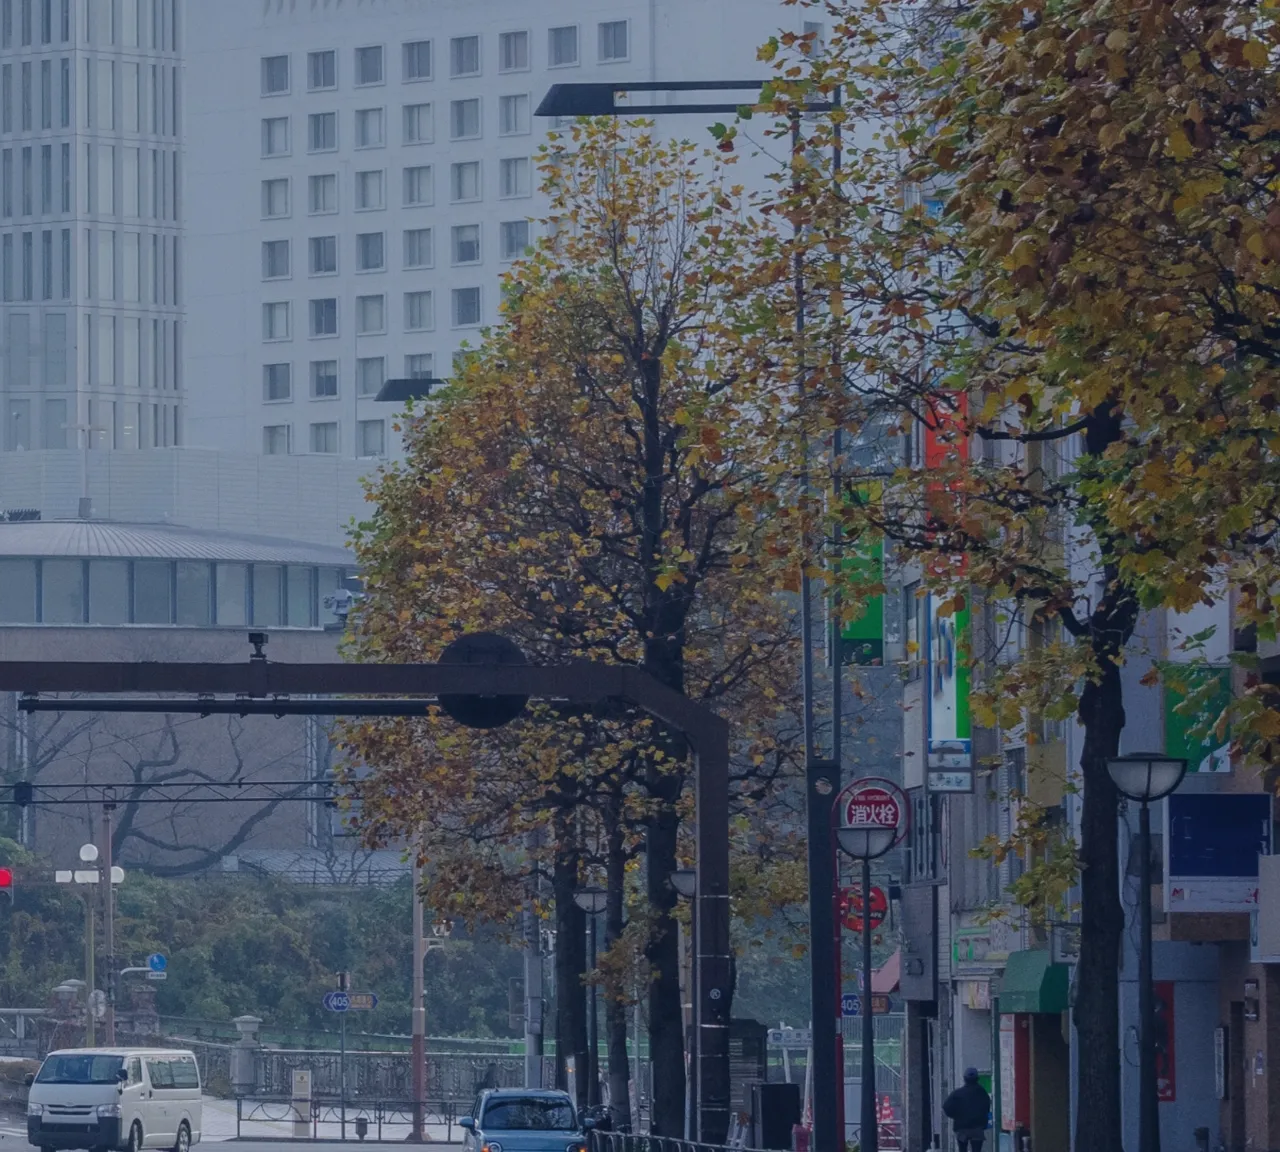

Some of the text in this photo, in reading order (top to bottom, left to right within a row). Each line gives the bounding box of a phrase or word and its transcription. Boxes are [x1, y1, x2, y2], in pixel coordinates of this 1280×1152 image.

[851, 804, 895, 825] 消火栓
[331, 996, 348, 1008] 405
[841, 999, 859, 1011] 405
